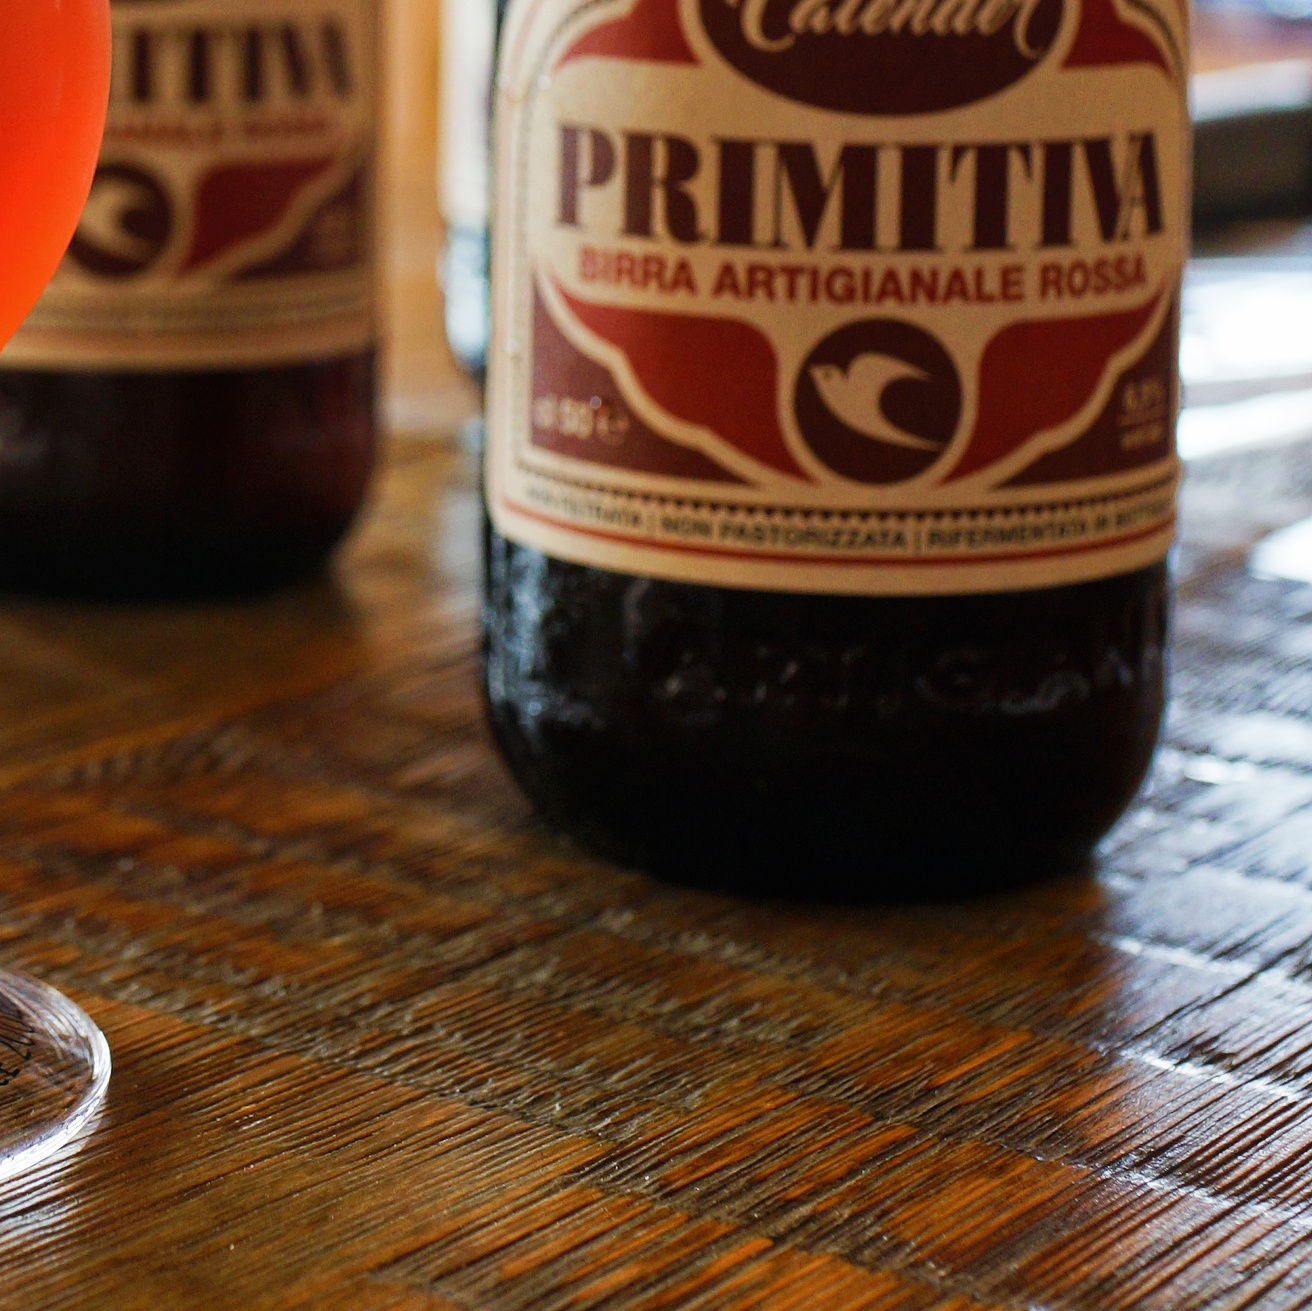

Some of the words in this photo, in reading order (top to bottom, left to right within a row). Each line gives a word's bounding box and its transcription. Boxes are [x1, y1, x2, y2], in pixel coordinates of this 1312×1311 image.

[555, 121, 1167, 255] PRIMITIVA
[577, 246, 700, 297] BIRRA
[711, 260, 1026, 305] ARTIGIANALE
[1038, 251, 1148, 297] ROSSA
